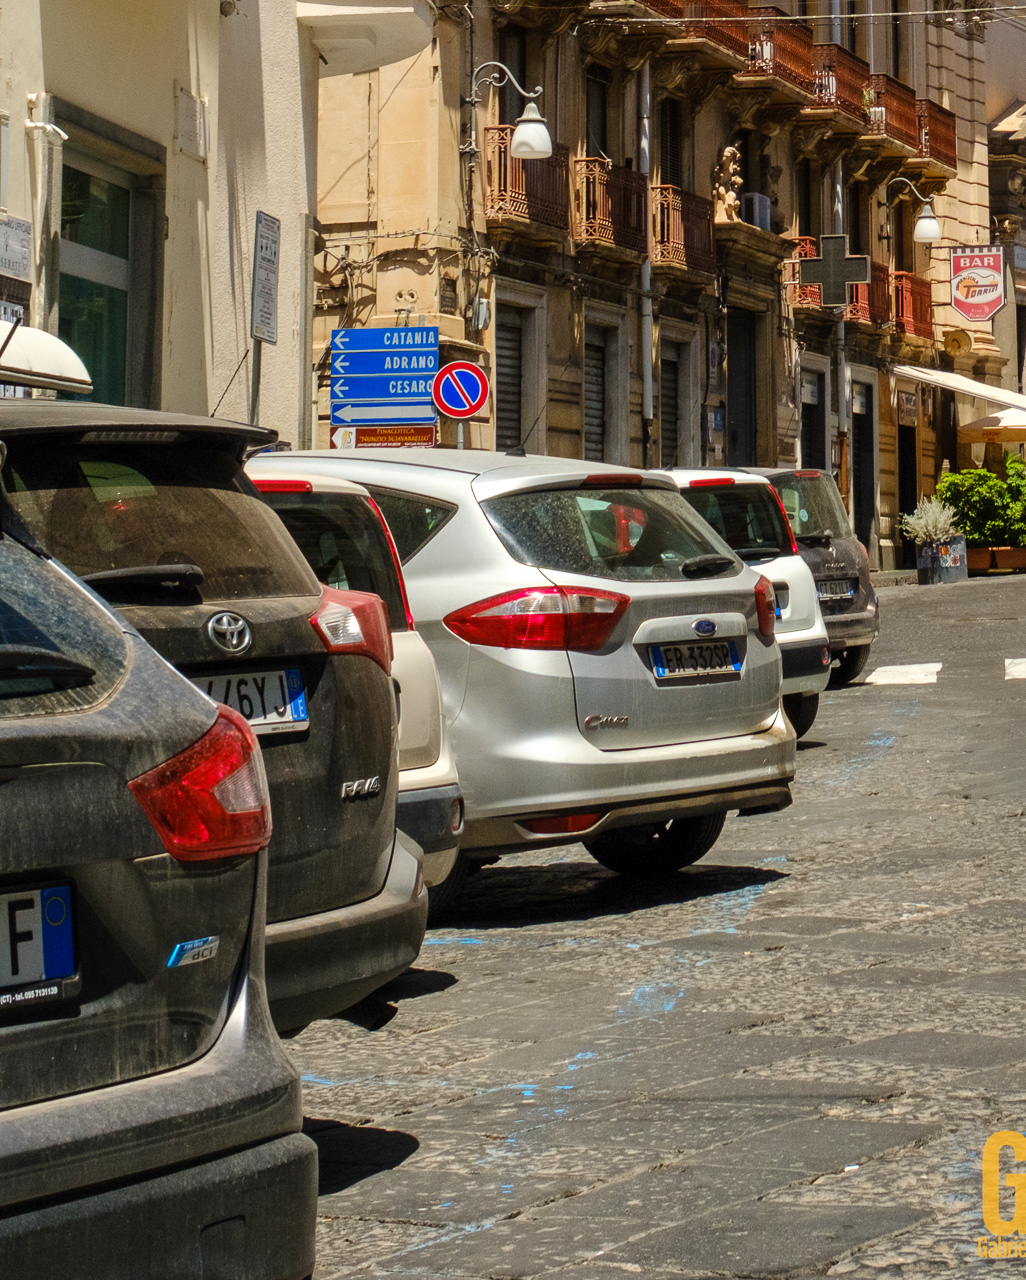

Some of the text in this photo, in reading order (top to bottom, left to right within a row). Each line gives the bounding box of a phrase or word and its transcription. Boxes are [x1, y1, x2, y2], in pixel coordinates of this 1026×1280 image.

[960, 257, 994, 267] BAR
[384, 331, 435, 345] CATANIA
[384, 355, 435, 370] ADRANO
[663, 646, 686, 674] FR
[8, 898, 35, 976] F
[192, 947, 213, 960] dCi
[0, 994, 12, 1005] (CT)
[15, 992, 24, 1001] tel.
[24, 990, 35, 999] 095
[35, 986, 58, 997] 7131139
